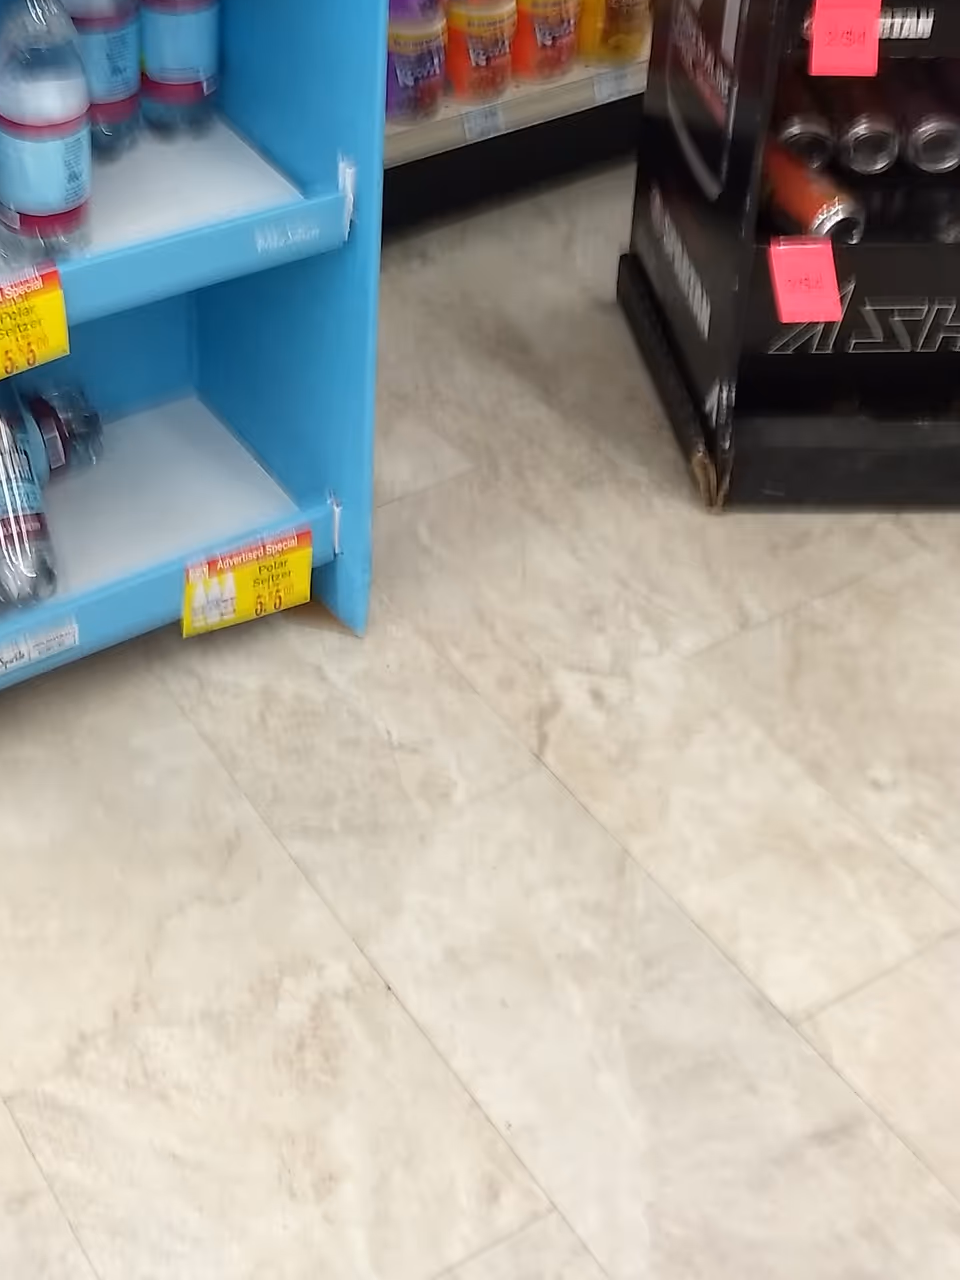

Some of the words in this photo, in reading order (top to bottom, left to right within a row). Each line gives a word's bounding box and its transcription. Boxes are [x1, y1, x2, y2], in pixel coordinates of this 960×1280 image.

[4, 276, 44, 300] Special
[0, 304, 36, 325] Polar
[217, 549, 264, 570] Advertised
[265, 536, 297, 555] Special
[258, 558, 288, 575] Polar
[252, 570, 292, 589] Seltzer
[0, 648, 26, 671] Sparkle
